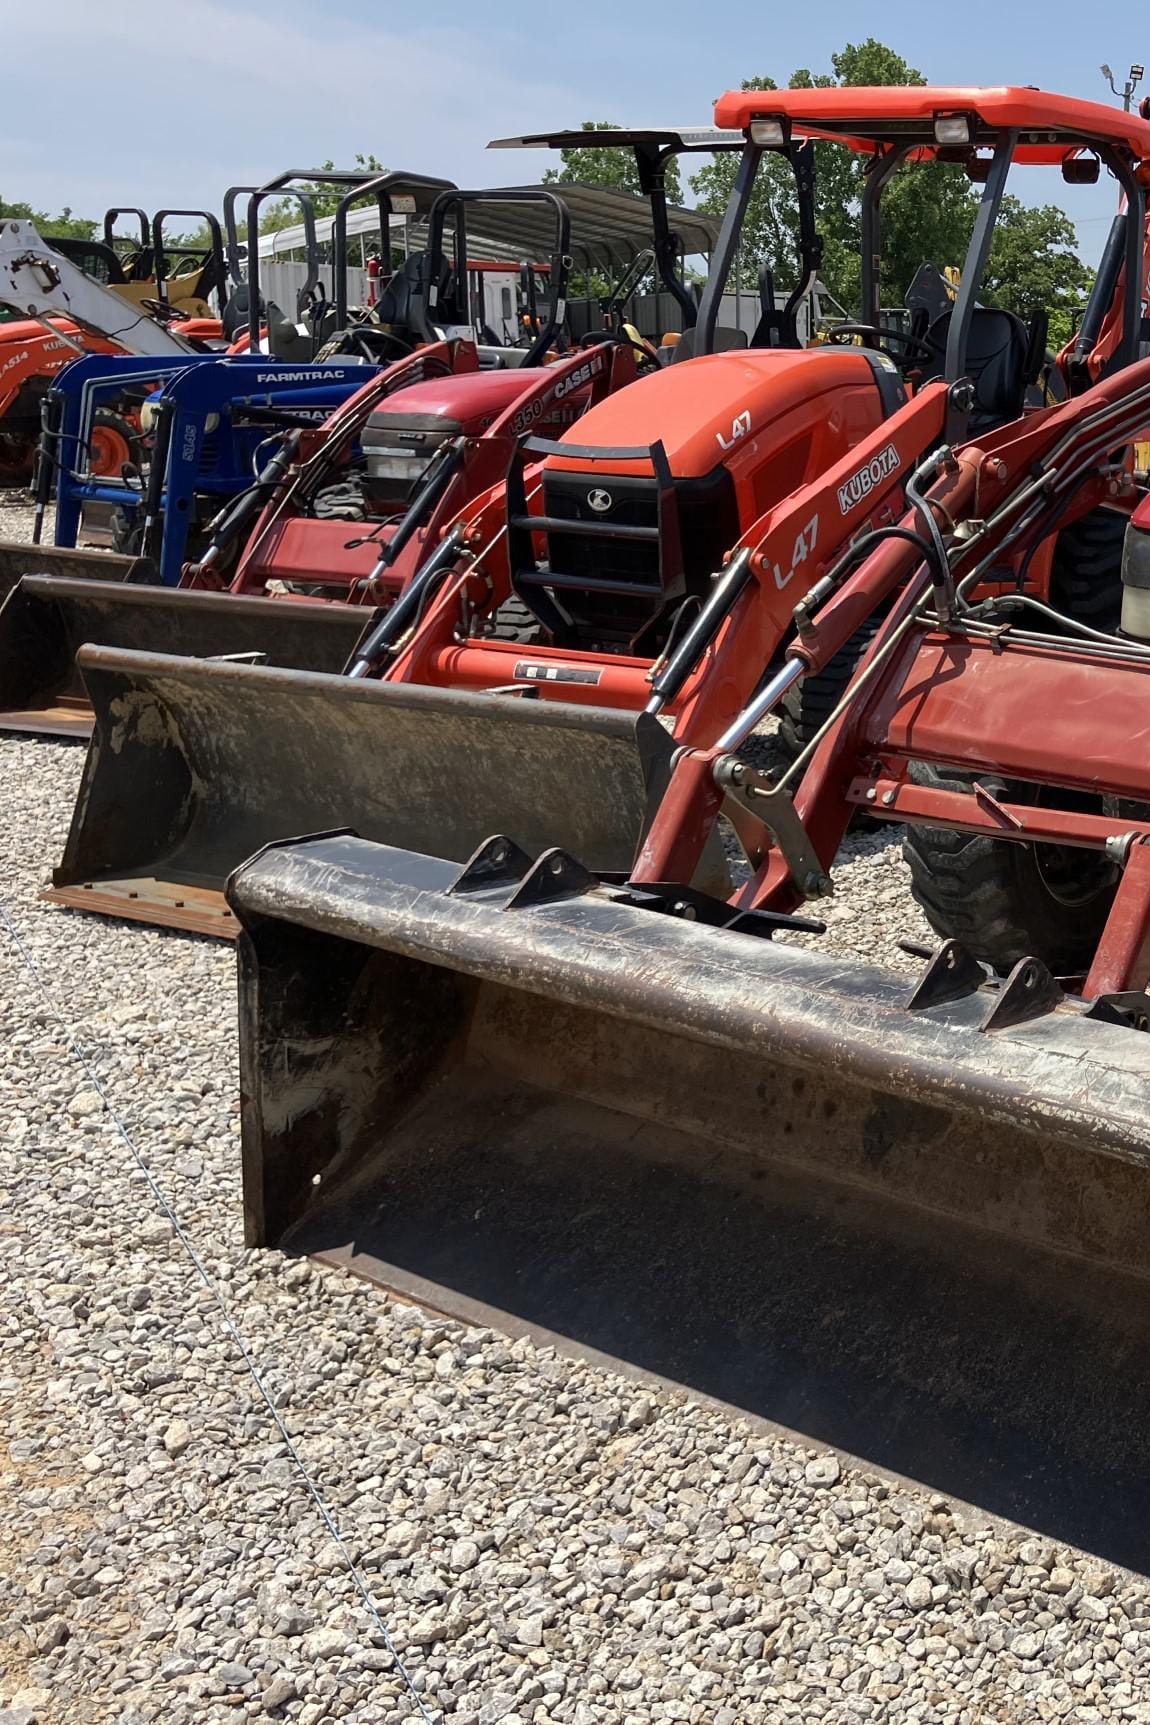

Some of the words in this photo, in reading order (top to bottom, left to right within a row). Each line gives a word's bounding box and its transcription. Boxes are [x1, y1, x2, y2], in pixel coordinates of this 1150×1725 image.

[42, 335, 85, 352] KUBTA
[257, 369, 345, 383] FARMTRAC
[554, 364, 592, 399] CASE
[715, 409, 752, 450] L47
[837, 443, 901, 516] KUBOTA
[773, 513, 820, 590] L47
